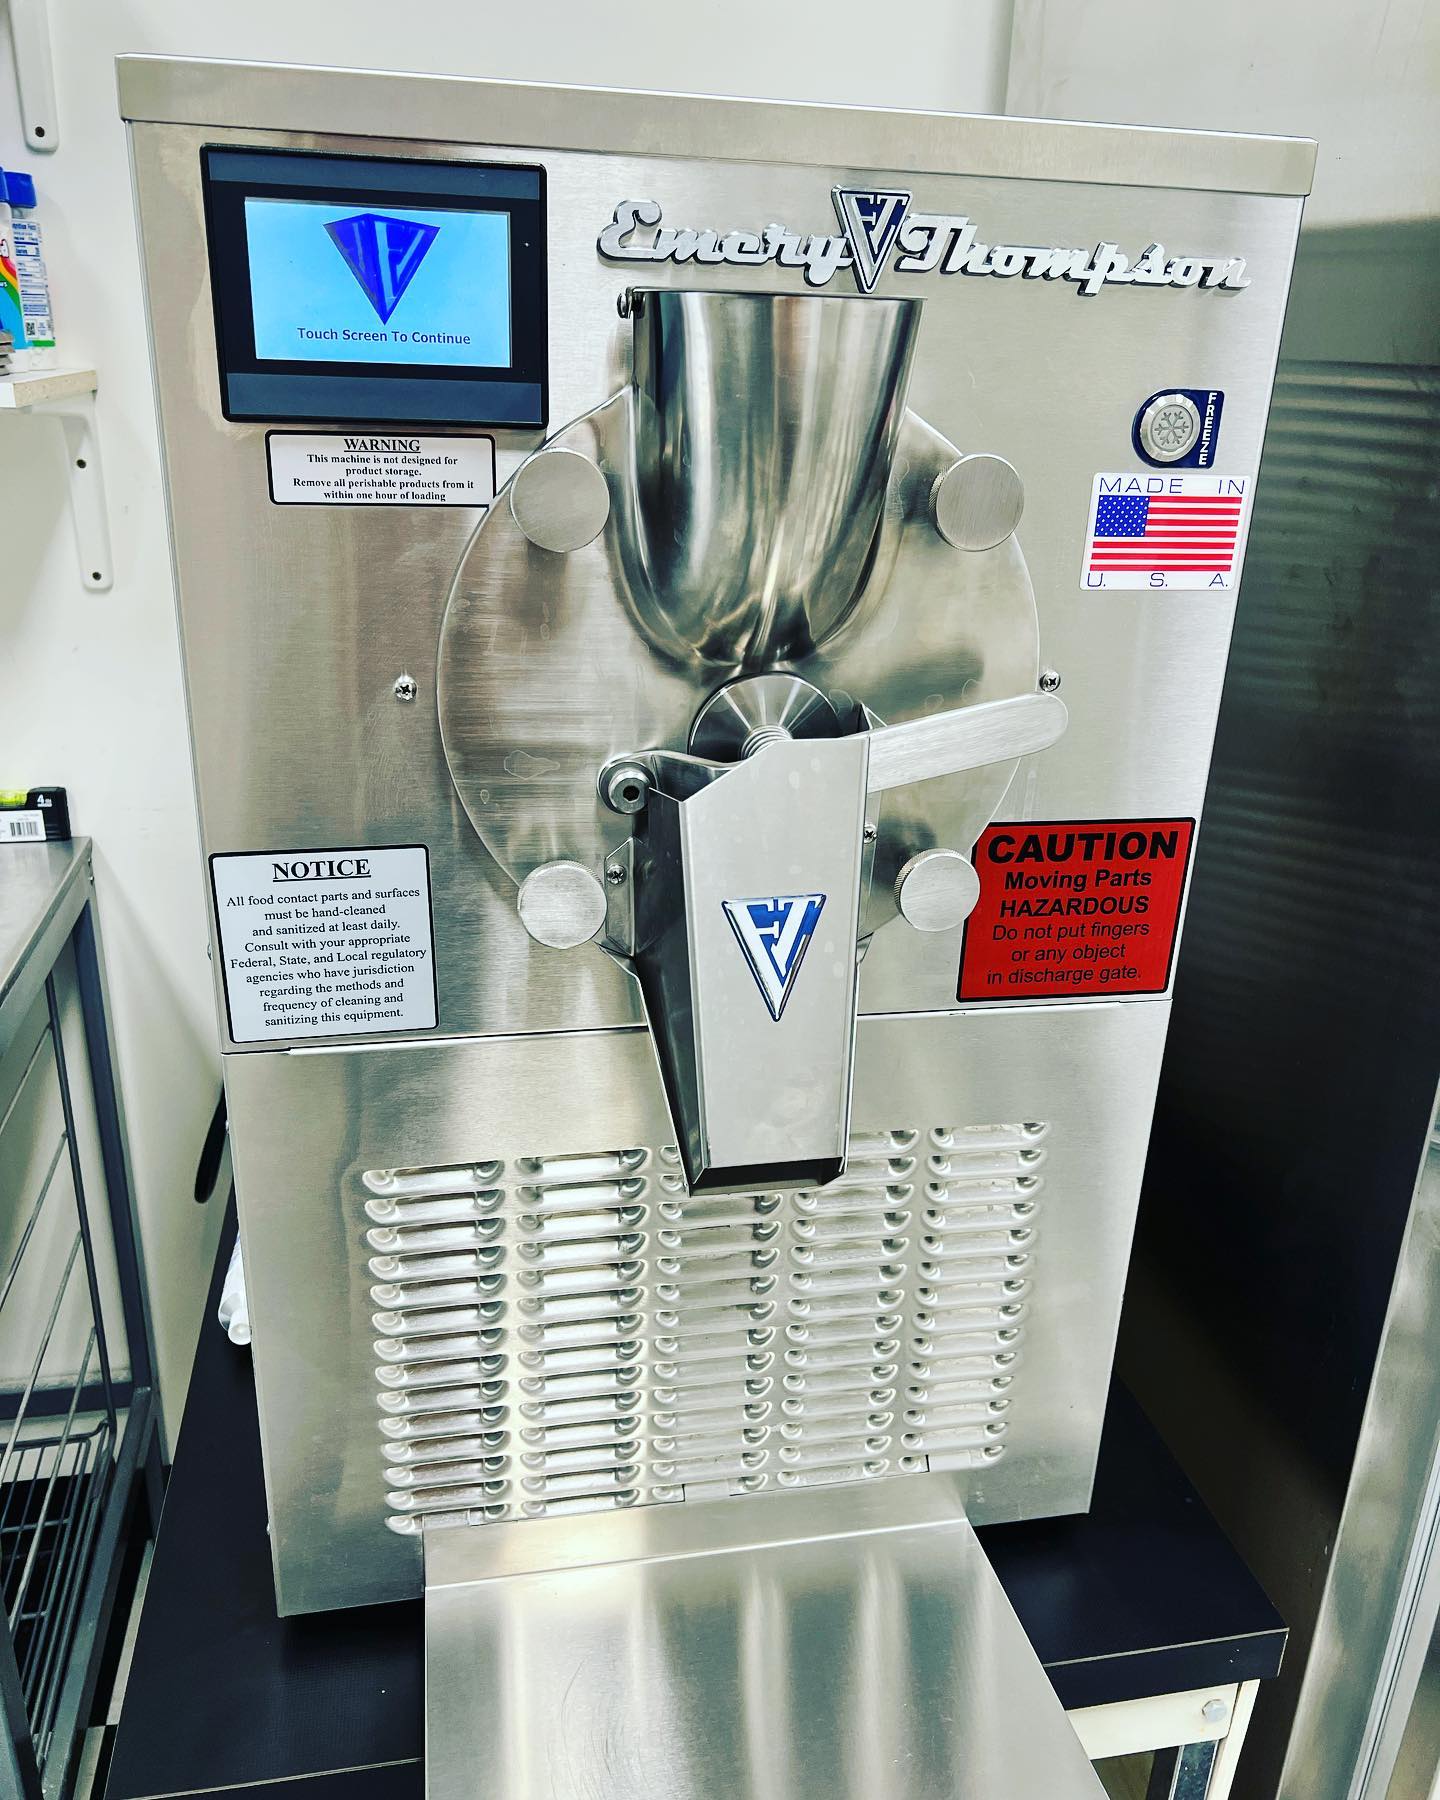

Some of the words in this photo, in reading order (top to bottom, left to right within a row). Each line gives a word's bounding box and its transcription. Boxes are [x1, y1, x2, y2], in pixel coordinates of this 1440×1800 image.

[596, 200, 853, 287] Emery
[894, 213, 1251, 296] Thompson
[297, 328, 338, 340] Touch
[342, 330, 388, 342] Screen
[392, 331, 408, 342] To
[412, 332, 470, 344] Continue
[1199, 392, 1217, 465] FREEZE
[344, 438, 421, 452] WARNING
[306, 454, 328, 464] This
[331, 455, 370, 464] machine
[373, 455, 380, 464] is
[384, 456, 399, 465] not
[401, 456, 441, 466] designed
[444, 456, 458, 465] for
[345, 467, 382, 476] product
[385, 468, 422, 476] storage.
[293, 478, 332, 487] Remove
[334, 478, 345, 487] all
[348, 479, 397, 489] perishable
[399, 480, 440, 489] products
[442, 480, 465, 489] from
[467, 480, 474, 489] it
[1100, 478, 1183, 494] MADE
[1218, 480, 1245, 494] IN
[324, 491, 353, 499] within
[375, 492, 398, 500] hour
[400, 492, 410, 500] of
[411, 492, 446, 502] loading
[988, 831, 1178, 863] CAUTION
[272, 859, 371, 880] NOTICE
[1004, 870, 1086, 892] Moving
[1095, 869, 1152, 887] Parts
[226, 896, 244, 907] All
[248, 895, 274, 906] food
[277, 894, 318, 904] contact
[321, 892, 349, 904] parts
[352, 890, 371, 900] and
[375, 888, 420, 899] surfaces
[1000, 896, 1149, 917] HAZARDOUS
[265, 911, 292, 921] must
[295, 909, 309, 918] be
[312, 905, 386, 917] hand-cleaned
[252, 926, 273, 937] and
[276, 924, 326, 936] sanitized
[329, 923, 340, 932] at
[342, 921, 368, 931] least
[370, 919, 400, 932] daily.
[992, 924, 1017, 940] Do
[1024, 924, 1052, 940] not
[1057, 924, 1086, 941] put
[1091, 922, 1150, 939] fingers
[245, 942, 288, 953] Consult
[291, 939, 317, 949] with
[320, 939, 345, 950] your
[348, 934, 410, 948] appropriate
[231, 956, 276, 969] Federal,
[279, 955, 310, 966] State,
[314, 953, 334, 964] and
[337, 951, 368, 962] Local
[371, 948, 426, 961] regulatory
[1011, 950, 1030, 962] or
[1035, 948, 1067, 964] any
[1072, 944, 1125, 962] object
[246, 971, 294, 985] agencies
[297, 969, 321, 979] who
[324, 968, 350, 978] have
[352, 964, 414, 978] jurisdiction
[988, 970, 1002, 984] in
[1008, 967, 1094, 984] discharge
[1100, 965, 1141, 984] gate.
[260, 985, 313, 998] regarding
[316, 984, 333, 993] the
[335, 982, 382, 992] methods
[384, 979, 404, 988] and
[263, 1000, 317, 1012] frequency
[320, 998, 333, 1007] of
[335, 996, 381, 1007] cleaning
[384, 993, 404, 1003] and
[265, 1014, 318, 1026] sanitizing
[321, 1012, 340, 1022] this
[344, 1009, 404, 1021] equipment.
